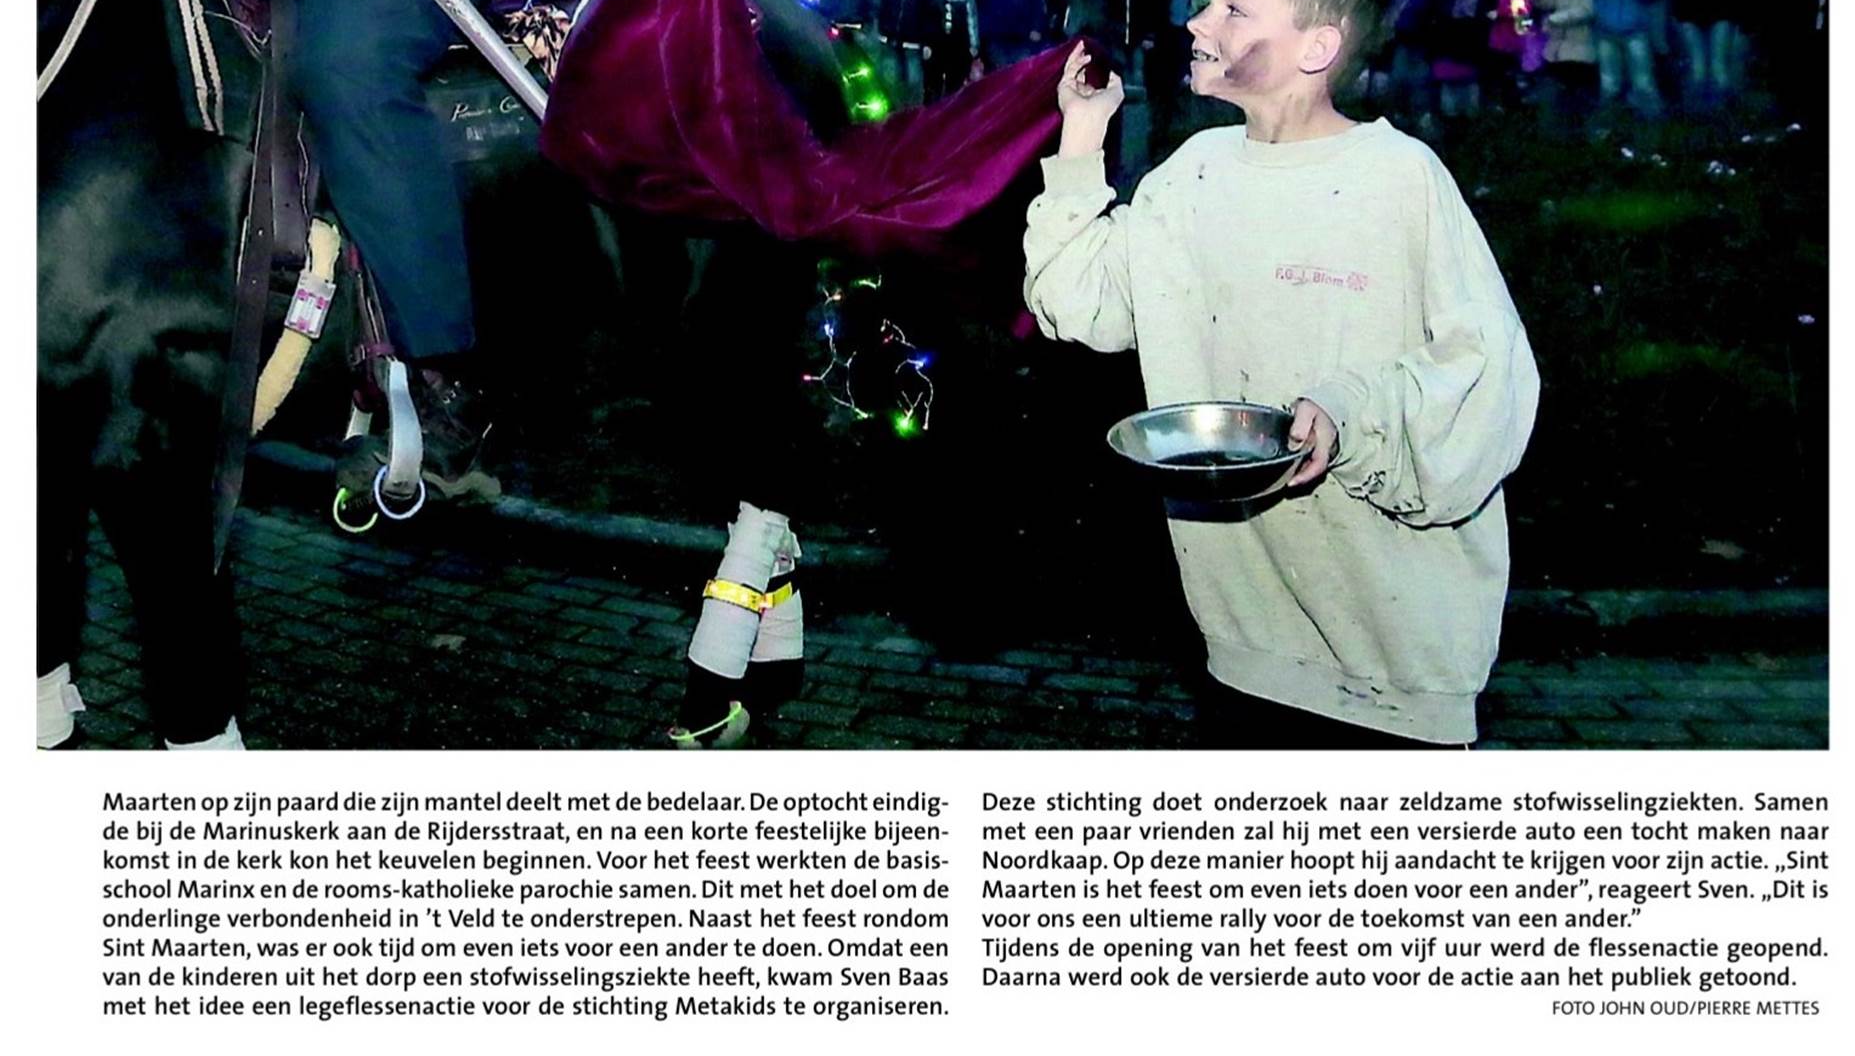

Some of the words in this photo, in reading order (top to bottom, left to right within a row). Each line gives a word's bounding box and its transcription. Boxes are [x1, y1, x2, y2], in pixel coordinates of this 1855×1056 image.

[1312, 270, 1345, 287] Blom
[102, 792, 196, 812] Maarten
[201, 796, 229, 817] op
[233, 791, 272, 818] zijn
[277, 791, 339, 817] paard
[343, 791, 377, 812] die
[381, 791, 419, 818] zijn
[425, 791, 501, 812] mantel
[506, 791, 562, 812] deelt
[567, 792, 611, 812] met
[615, 791, 642, 812] de
[647, 791, 746, 812] bedelaar.
[750, 792, 779, 812] De
[783, 791, 868, 817] optocht
[872, 791, 949, 818] eindig-
[982, 792, 1036, 812] Deze
[1046, 791, 1142, 818] stichting
[1152, 791, 1202, 812] doet
[1214, 791, 1328, 812] onderzoek
[1340, 796, 1389, 811] naar
[1399, 791, 1503, 812] zeldzame
[1513, 791, 1744, 818] stofwisselingziekten.
[1754, 792, 1828, 812] Samen
[102, 820, 129, 841] de
[137, 820, 163, 847] bij
[169, 820, 196, 841] de
[203, 820, 340, 841] Marinuskerk
[347, 825, 386, 841] aan
[394, 820, 421, 841] de
[428, 820, 571, 847] Rijdersstraat,
[576, 825, 603, 841] en
[610, 825, 637, 841] na
[644, 825, 684, 841] een
[691, 820, 748, 841] korte
[754, 820, 867, 847] feestelijke
[874, 820, 949, 847] bijeen-
[982, 821, 1026, 841] met
[1034, 825, 1074, 841] een
[1083, 825, 1132, 847] paar
[1139, 820, 1235, 841] vrienden
[1244, 820, 1274, 841] zal
[1283, 820, 1309, 847] hij
[1318, 821, 1362, 841] met
[1370, 825, 1409, 841] een
[1417, 820, 1517, 841] versierde
[1525, 821, 1576, 841] auto
[1583, 825, 1622, 841] een
[1631, 820, 1689, 841] tocht
[1697, 820, 1771, 841] maken
[1780, 825, 1830, 841] naar
[102, 878, 171, 899] school
[177, 879, 255, 899] Marinx
[260, 884, 287, 899] en
[292, 878, 319, 899] de
[324, 878, 514, 899] rooms-katholieke
[520, 878, 613, 905] parochie
[618, 884, 697, 899] samen.
[702, 879, 734, 899] Dit
[740, 880, 783, 899] met
[789, 878, 825, 899] het
[830, 878, 877, 899] doel
[882, 884, 917, 899] om
[923, 878, 950, 899] de
[981, 913, 1031, 928] voor
[1037, 913, 1075, 928] ons
[1082, 913, 1121, 928] een
[1129, 907, 1213, 928] ultieme
[1220, 907, 1267, 934] rally
[1273, 913, 1322, 928] voor
[1328, 907, 1355, 928] de
[1360, 907, 1465, 928] toekomst
[1471, 913, 1511, 928] van
[1518, 913, 1557, 928] een
[1564, 907, 1641, 928] ander.”
[102, 937, 145, 957] Sint
[151, 938, 251, 961] Maarten,
[256, 942, 299, 957] was
[305, 942, 328, 957] er
[333, 936, 373, 957] ook
[378, 937, 415, 963] tijd
[420, 942, 456, 957] om
[463, 942, 513, 957] even
[521, 937, 559, 957] iets
[564, 942, 614, 957] voor
[619, 942, 659, 957] een
[665, 936, 729, 957] ander
[733, 938, 756, 957] te
[762, 936, 823, 957] doen.
[827, 936, 904, 957] Omdat
[909, 942, 949, 957] een
[981, 936, 1059, 963] Tijdens
[1068, 936, 1095, 957] de
[1103, 937, 1193, 964] opening
[1200, 942, 1240, 957] van
[1250, 937, 1286, 957] het
[1294, 936, 1348, 957] feest
[1357, 942, 1392, 957] om
[1400, 936, 1437, 963] vijf
[1445, 942, 1482, 957] uur
[1490, 936, 1545, 957] werd
[1553, 937, 1580, 957] de
[1588, 936, 1719, 957] flessenactie
[1727, 936, 1828, 963] geopend.
[102, 971, 141, 986] van
[148, 966, 175, 986] de
[182, 966, 278, 986] kinderen
[285, 967, 315, 986] uit
[322, 966, 358, 986] het
[365, 966, 417, 992] dorp
[423, 971, 462, 986] een
[469, 965, 691, 993] stofwisselingsziekte
[698, 965, 761, 990] heeft,
[767, 966, 833, 986] kwam
[840, 967, 891, 986] Sven
[899, 967, 949, 986] Baas
[982, 967, 1061, 986] Daarna
[1068, 966, 1122, 986] werd
[1130, 966, 1170, 986] ook
[1176, 966, 1204, 986] de
[1209, 966, 1309, 986] versierde
[1315, 967, 1366, 986] auto
[1372, 971, 1421, 986] voor
[1428, 966, 1454, 986] de
[1460, 967, 1514, 986] actie
[1520, 971, 1560, 986] aan
[1568, 966, 1604, 986] het
[1611, 966, 1692, 992] publiek
[1699, 966, 1797, 993] getoond.
[103, 996, 146, 1016] met
[155, 995, 191, 1016] het
[199, 995, 245, 1016] idee
[252, 1000, 291, 1016] een
[299, 995, 476, 1022] legeflessenactie
[482, 1000, 531, 1016] voor
[538, 995, 565, 1016] de
[572, 995, 668, 1022] stichting
[675, 995, 776, 1016] Metakids
[783, 996, 806, 1016] te
[813, 996, 949, 1022] organiseren.
[1552, 1000, 1595, 1016] FOTO
[1599, 1000, 1645, 1016] JOHN
[1650, 1000, 1751, 1016] OUD/PIERRE
[1756, 1000, 1820, 1016] METTES
